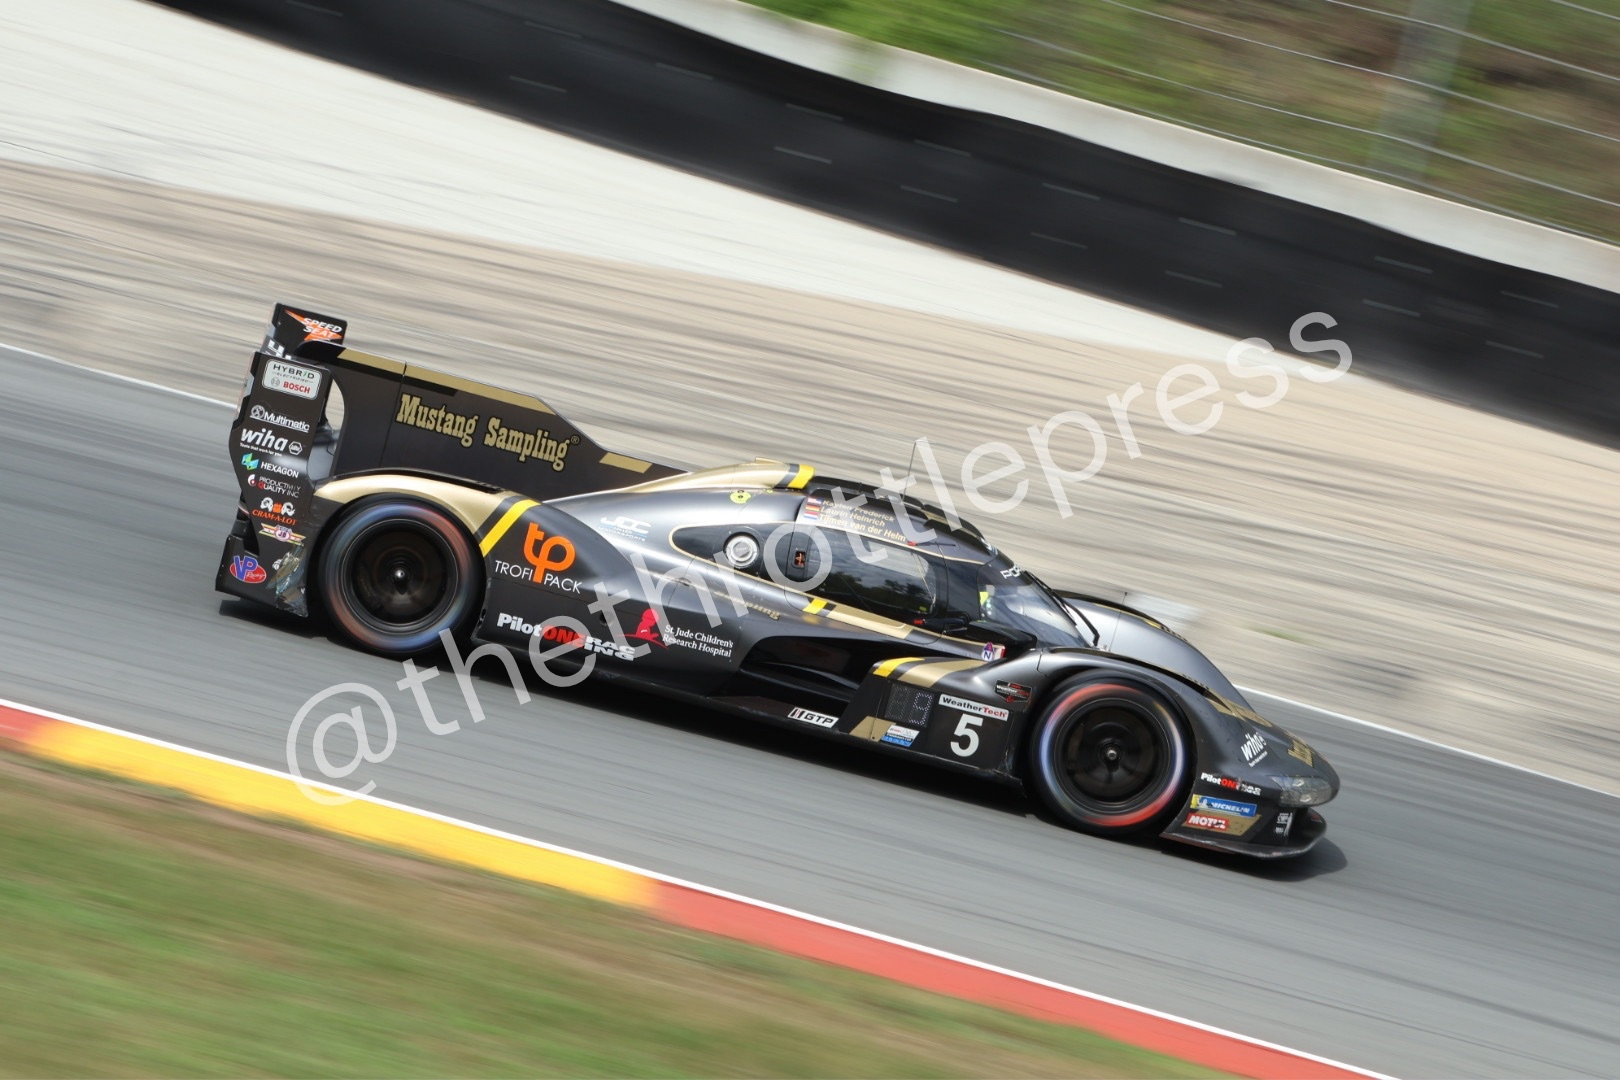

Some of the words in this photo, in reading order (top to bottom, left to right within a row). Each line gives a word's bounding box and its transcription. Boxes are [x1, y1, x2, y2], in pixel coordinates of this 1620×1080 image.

[303, 317, 343, 333] SPEED
[303, 325, 336, 339] SEAT
[273, 364, 315, 379] HYBRID
[283, 381, 311, 394] BOSCH
[263, 411, 310, 431] Multimatic
[396, 393, 479, 448] Mustang
[240, 427, 289, 452] wiha
[260, 461, 300, 479] HEXAGON
[258, 481, 287, 495] QUALITY
[252, 509, 298, 526] CRAM-A-LOT
[867, 526, 882, 536] der
[882, 532, 907, 542] Helm
[233, 555, 258, 581] VP
[495, 560, 533, 580] TROFI
[544, 573, 583, 594] PACK
[662, 633, 697, 650] Research
[698, 642, 732, 658] Hospital
[675, 627, 694, 639] Jude
[694, 632, 734, 648] Children's
[942, 696, 1008, 718] WeatherTech
[804, 712, 834, 726] GTP
[950, 713, 983, 757] 5
